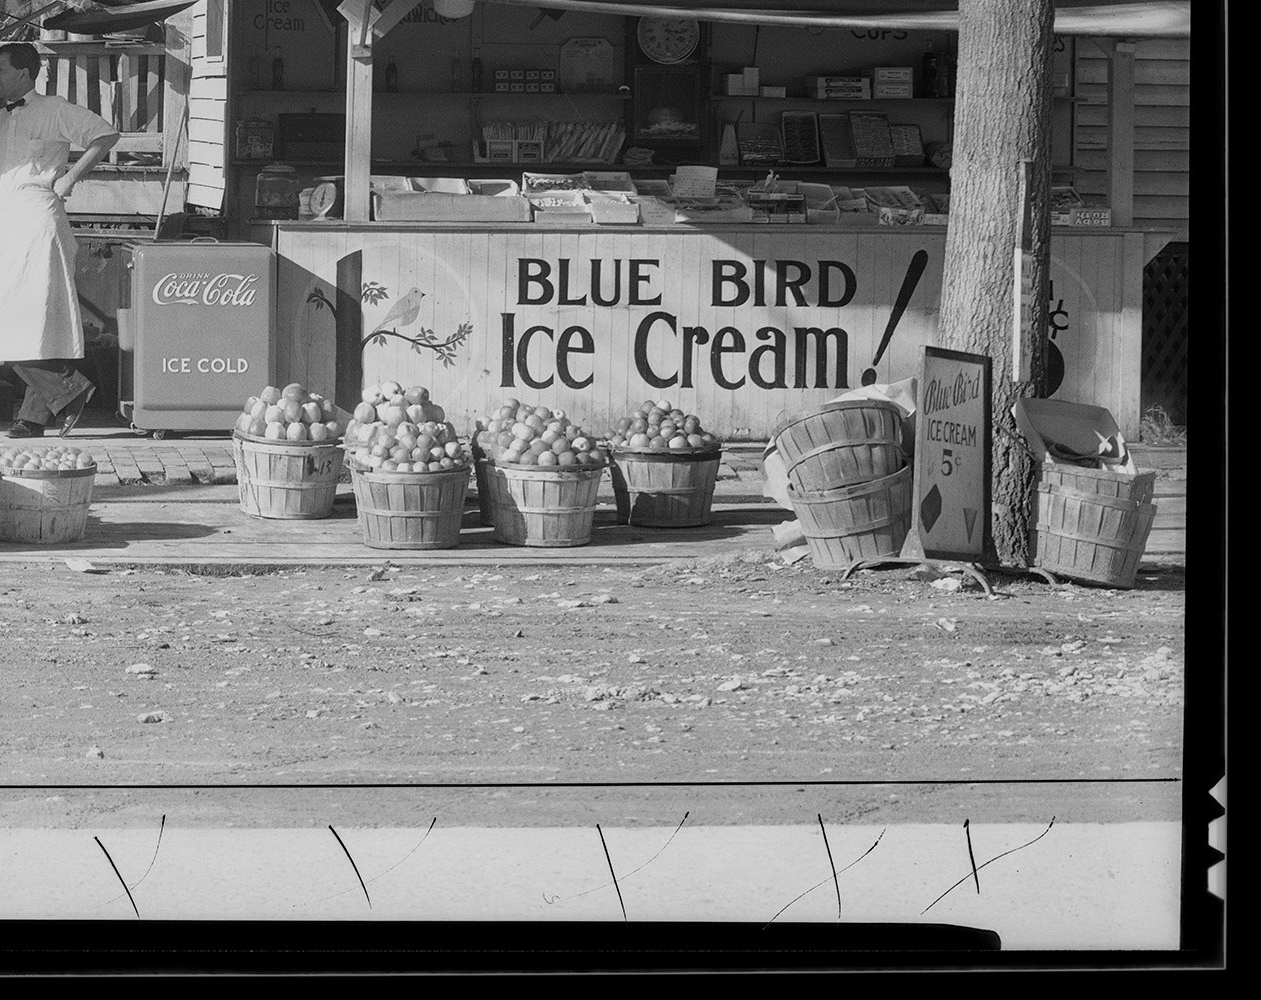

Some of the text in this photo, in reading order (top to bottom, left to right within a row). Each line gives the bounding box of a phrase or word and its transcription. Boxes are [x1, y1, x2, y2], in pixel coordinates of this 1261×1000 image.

[269, 0, 291, 14] Ice
[253, 13, 305, 32] Cream
[152, 273, 260, 306] Coca-Cola
[516, 257, 857, 307] BLUE BIRD
[162, 358, 249, 373] ICE COLD
[500, 312, 595, 389] Ice
[924, 369, 981, 416] Blue Bird
[927, 419, 977, 447] ICE CREAM
